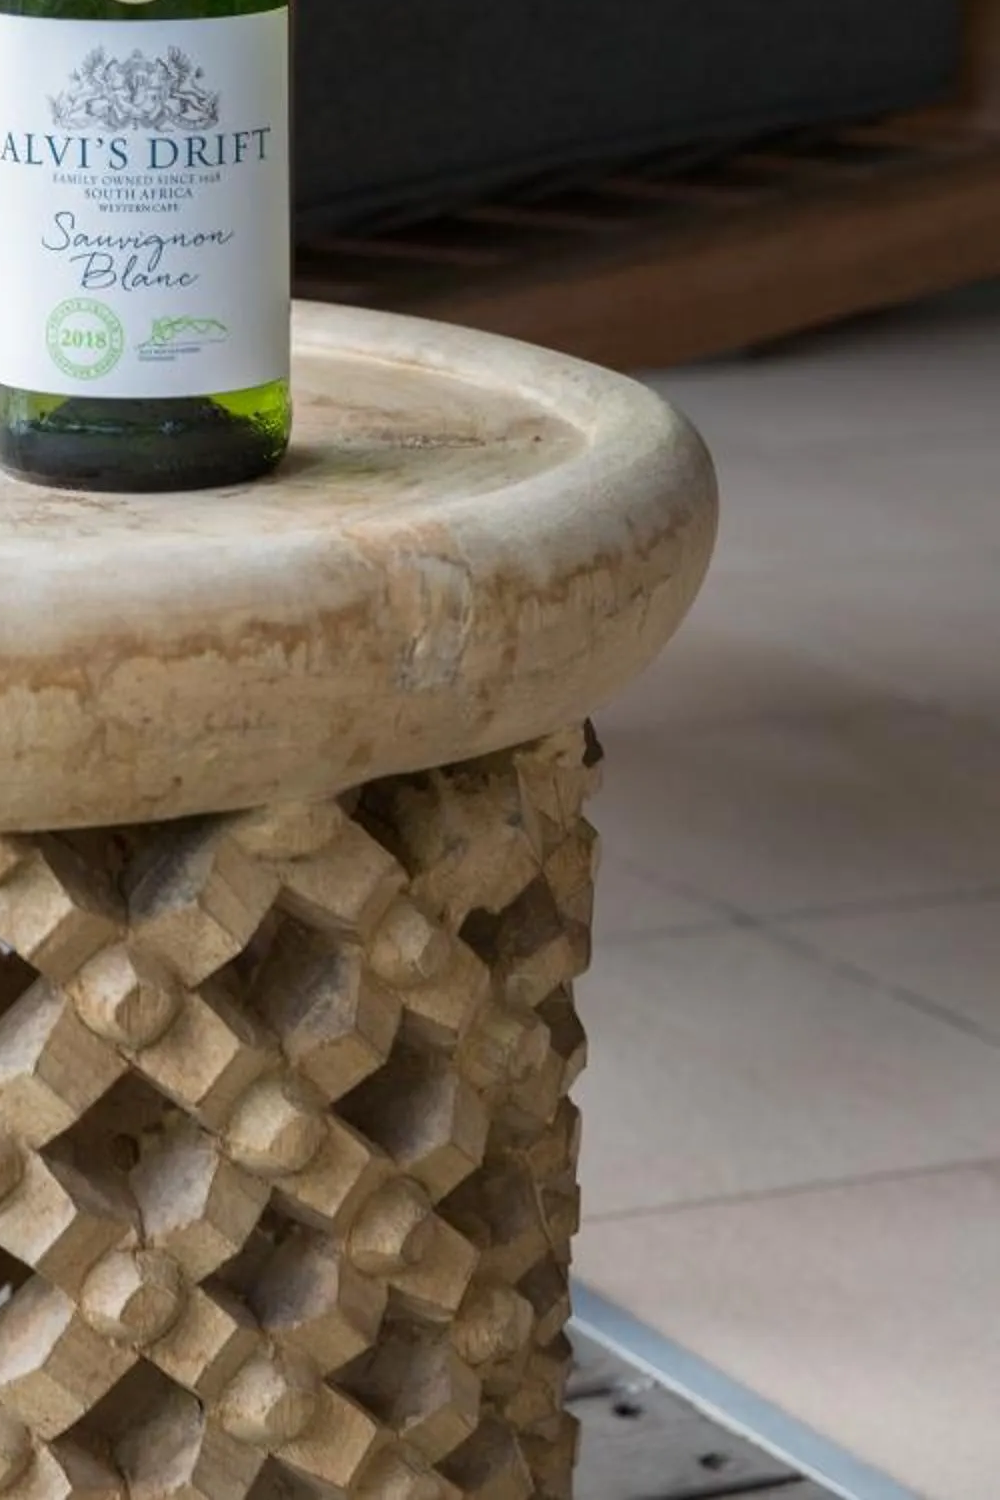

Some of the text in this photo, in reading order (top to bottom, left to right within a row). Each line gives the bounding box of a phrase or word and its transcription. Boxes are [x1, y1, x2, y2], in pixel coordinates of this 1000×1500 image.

[0, 127, 272, 171] ALVI'S DRIFT
[52, 173, 97, 186] FAMILY
[101, 174, 153, 186] OWNED
[157, 173, 198, 186] SINCE
[84, 187, 193, 200] SOUTH AFRICA
[99, 202, 180, 213] WESTERN CAPE
[41, 211, 235, 272] Sauvignon
[70, 251, 199, 291] Blanc
[61, 328, 107, 349] 2018
